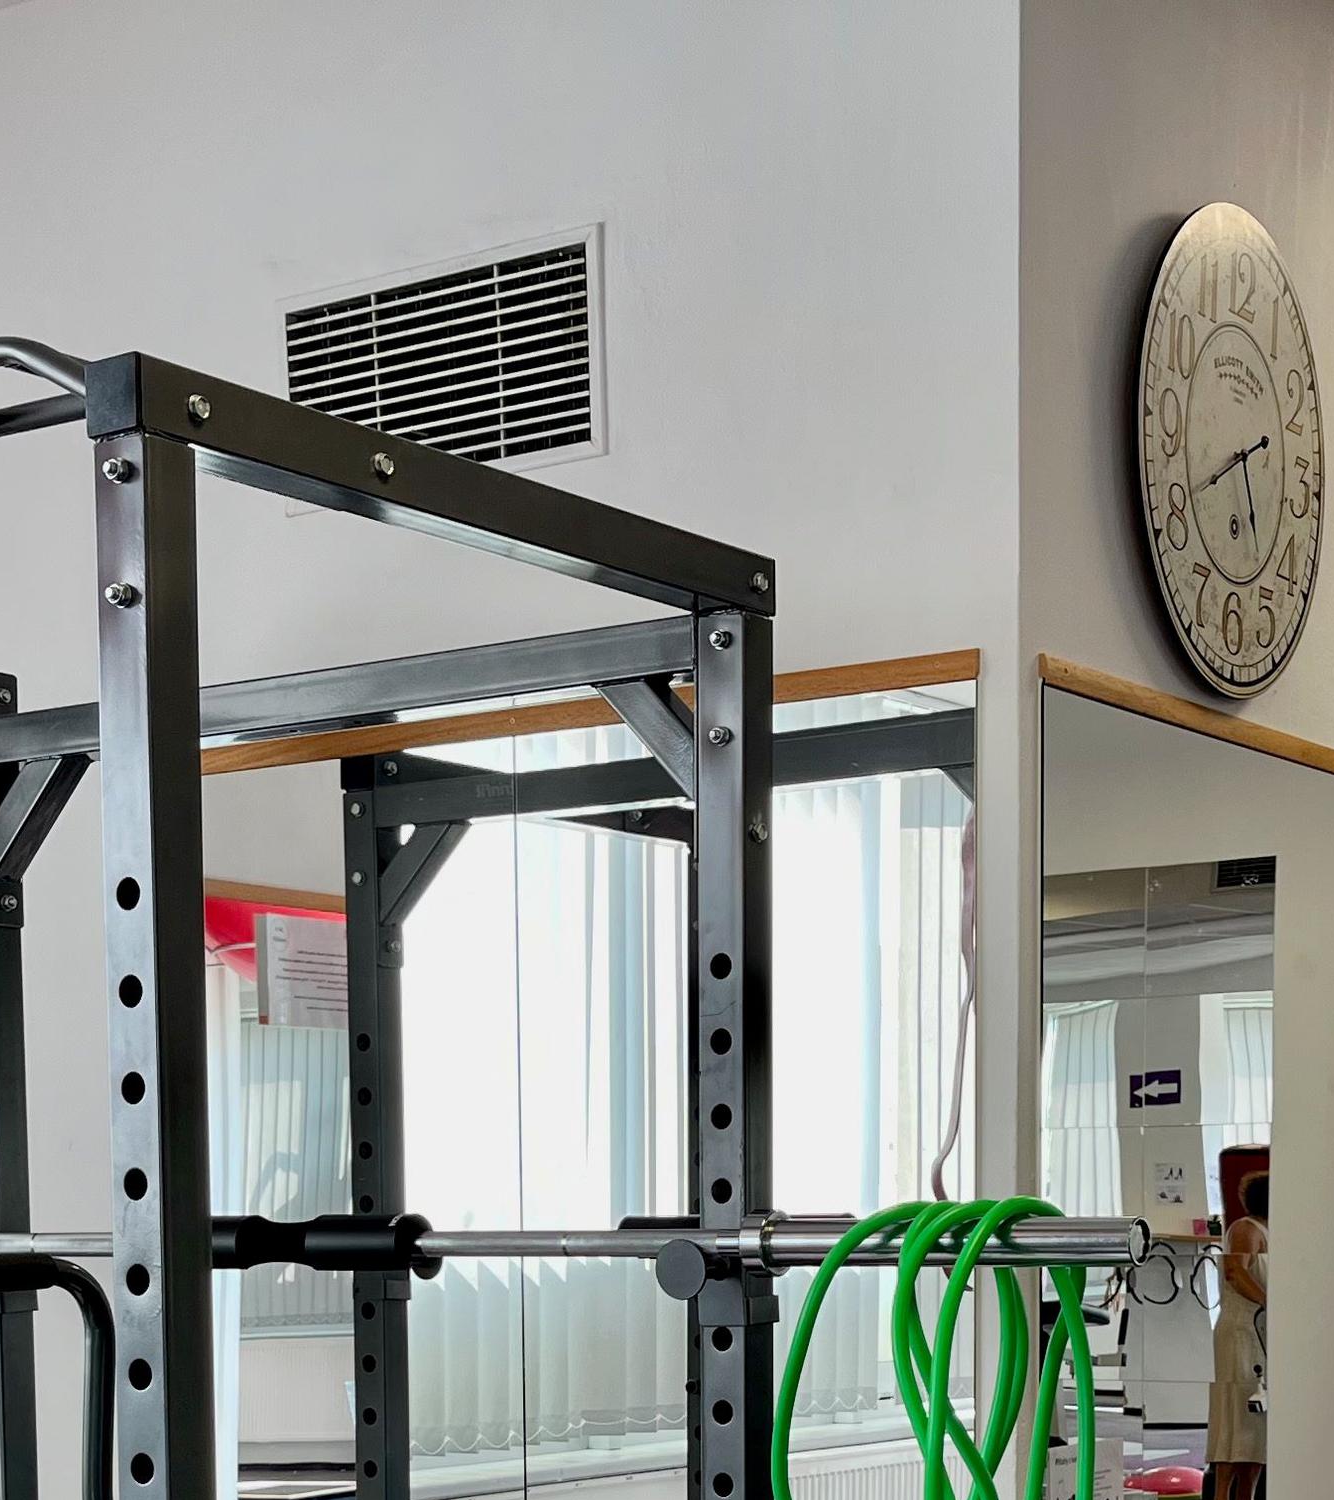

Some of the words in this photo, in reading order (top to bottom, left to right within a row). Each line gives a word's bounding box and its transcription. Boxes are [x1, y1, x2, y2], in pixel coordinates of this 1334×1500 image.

[1198, 254, 1218, 323] 11
[1229, 250, 1256, 324] 12
[1168, 309, 1195, 379] 10
[1159, 388, 1182, 457] 9
[1285, 369, 1304, 436] 2
[1167, 483, 1188, 550] 8
[1290, 456, 1310, 519] 3
[1193, 562, 1211, 628] 7
[1276, 534, 1297, 597] 4
[1222, 592, 1243, 655] 6
[1256, 586, 1275, 648] 5
